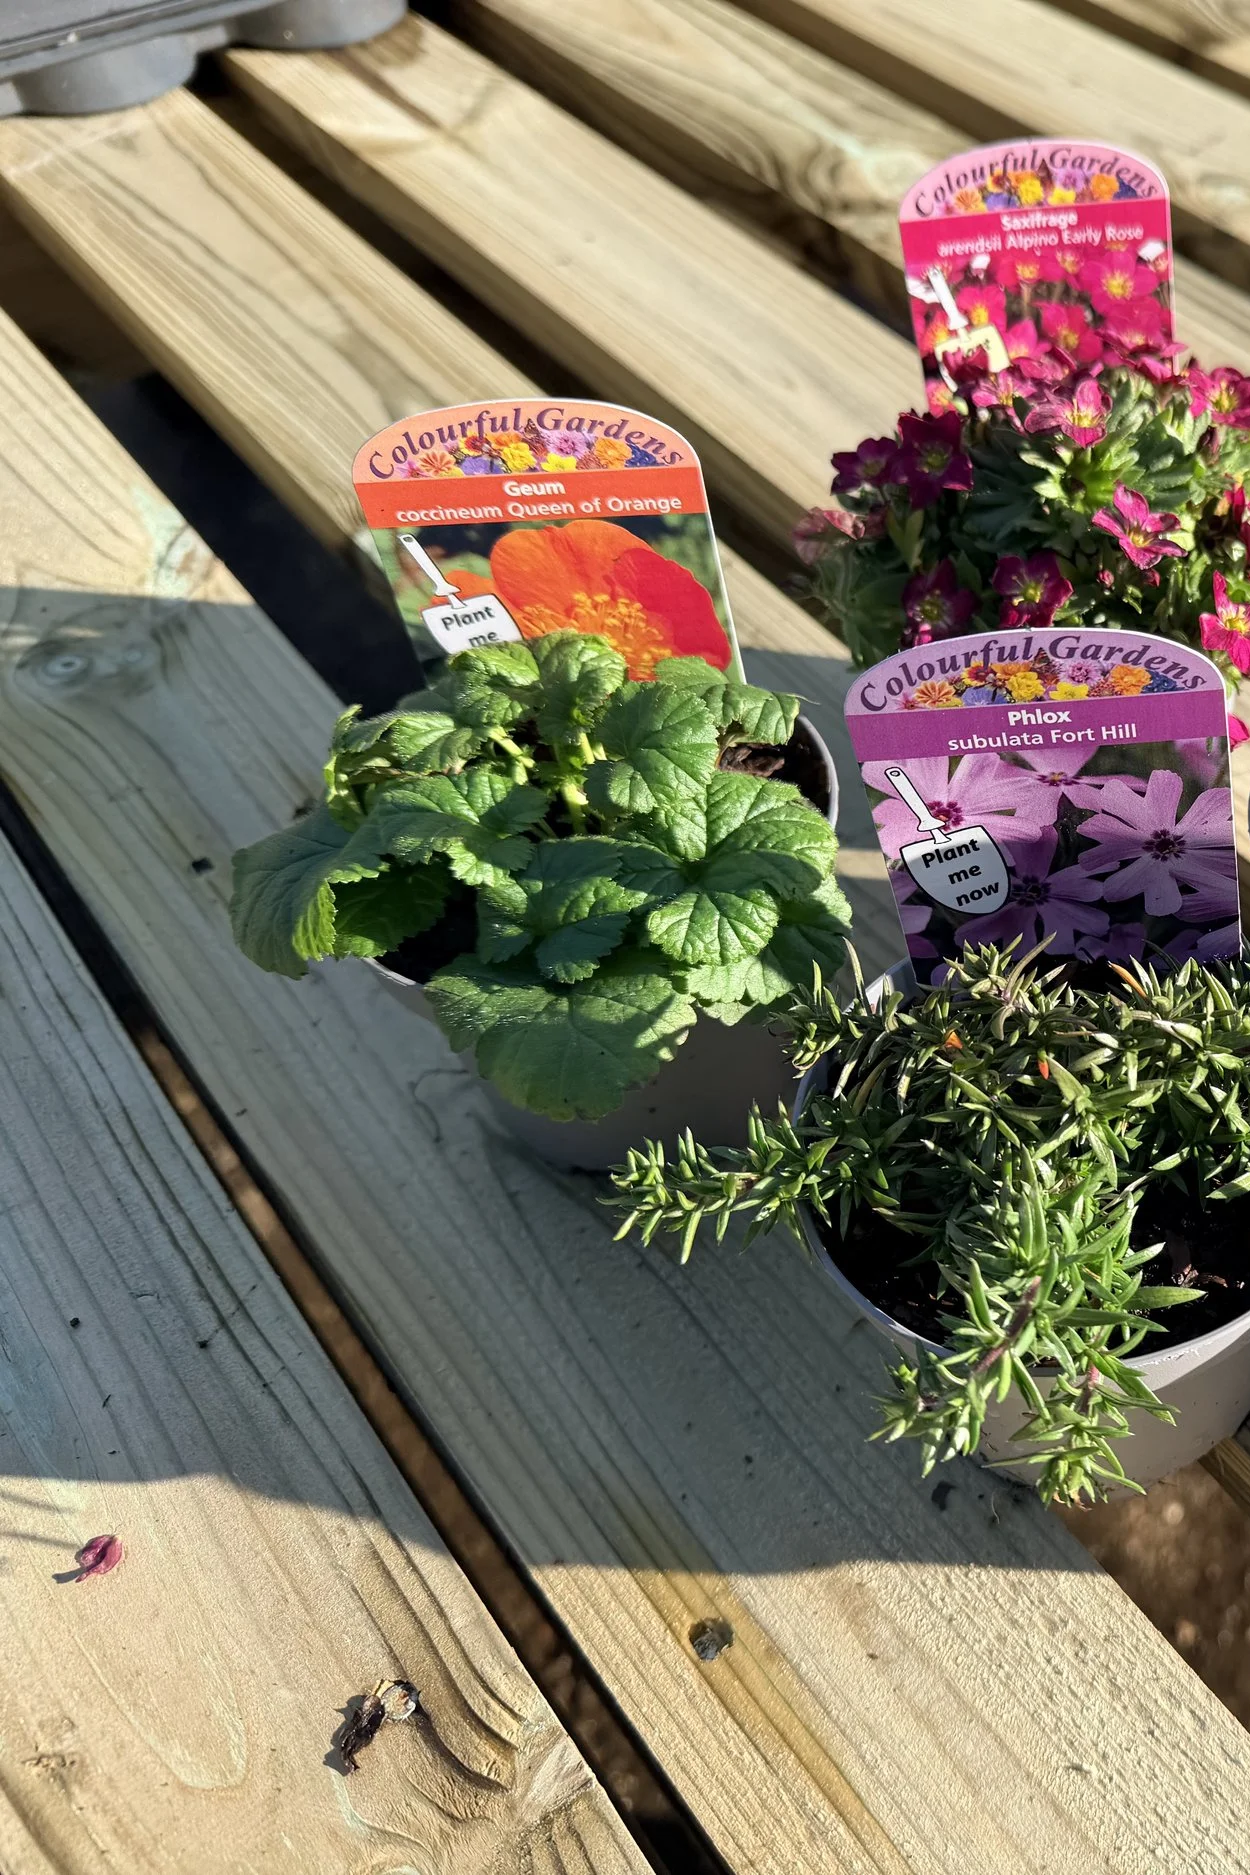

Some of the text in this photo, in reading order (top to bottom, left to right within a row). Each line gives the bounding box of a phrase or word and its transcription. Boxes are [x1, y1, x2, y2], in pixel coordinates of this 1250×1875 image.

[914, 148, 1158, 218] Colourful Gardens
[1001, 210, 1078, 232] Saxifrage
[938, 224, 1144, 257] arendsii Alpino Early Rose
[369, 407, 684, 479] Colourful Gardens
[504, 480, 566, 497] Geum
[396, 497, 682, 522] coccineum Queen of Orange
[441, 606, 496, 631] Plant
[468, 631, 500, 647] me
[860, 635, 1207, 712] Colourful Gardens
[1008, 709, 1072, 725] Phlox
[947, 723, 1137, 751] subulata Fort Hill
[921, 838, 980, 868] Plant
[948, 865, 982, 884] me
[956, 882, 999, 906] now
